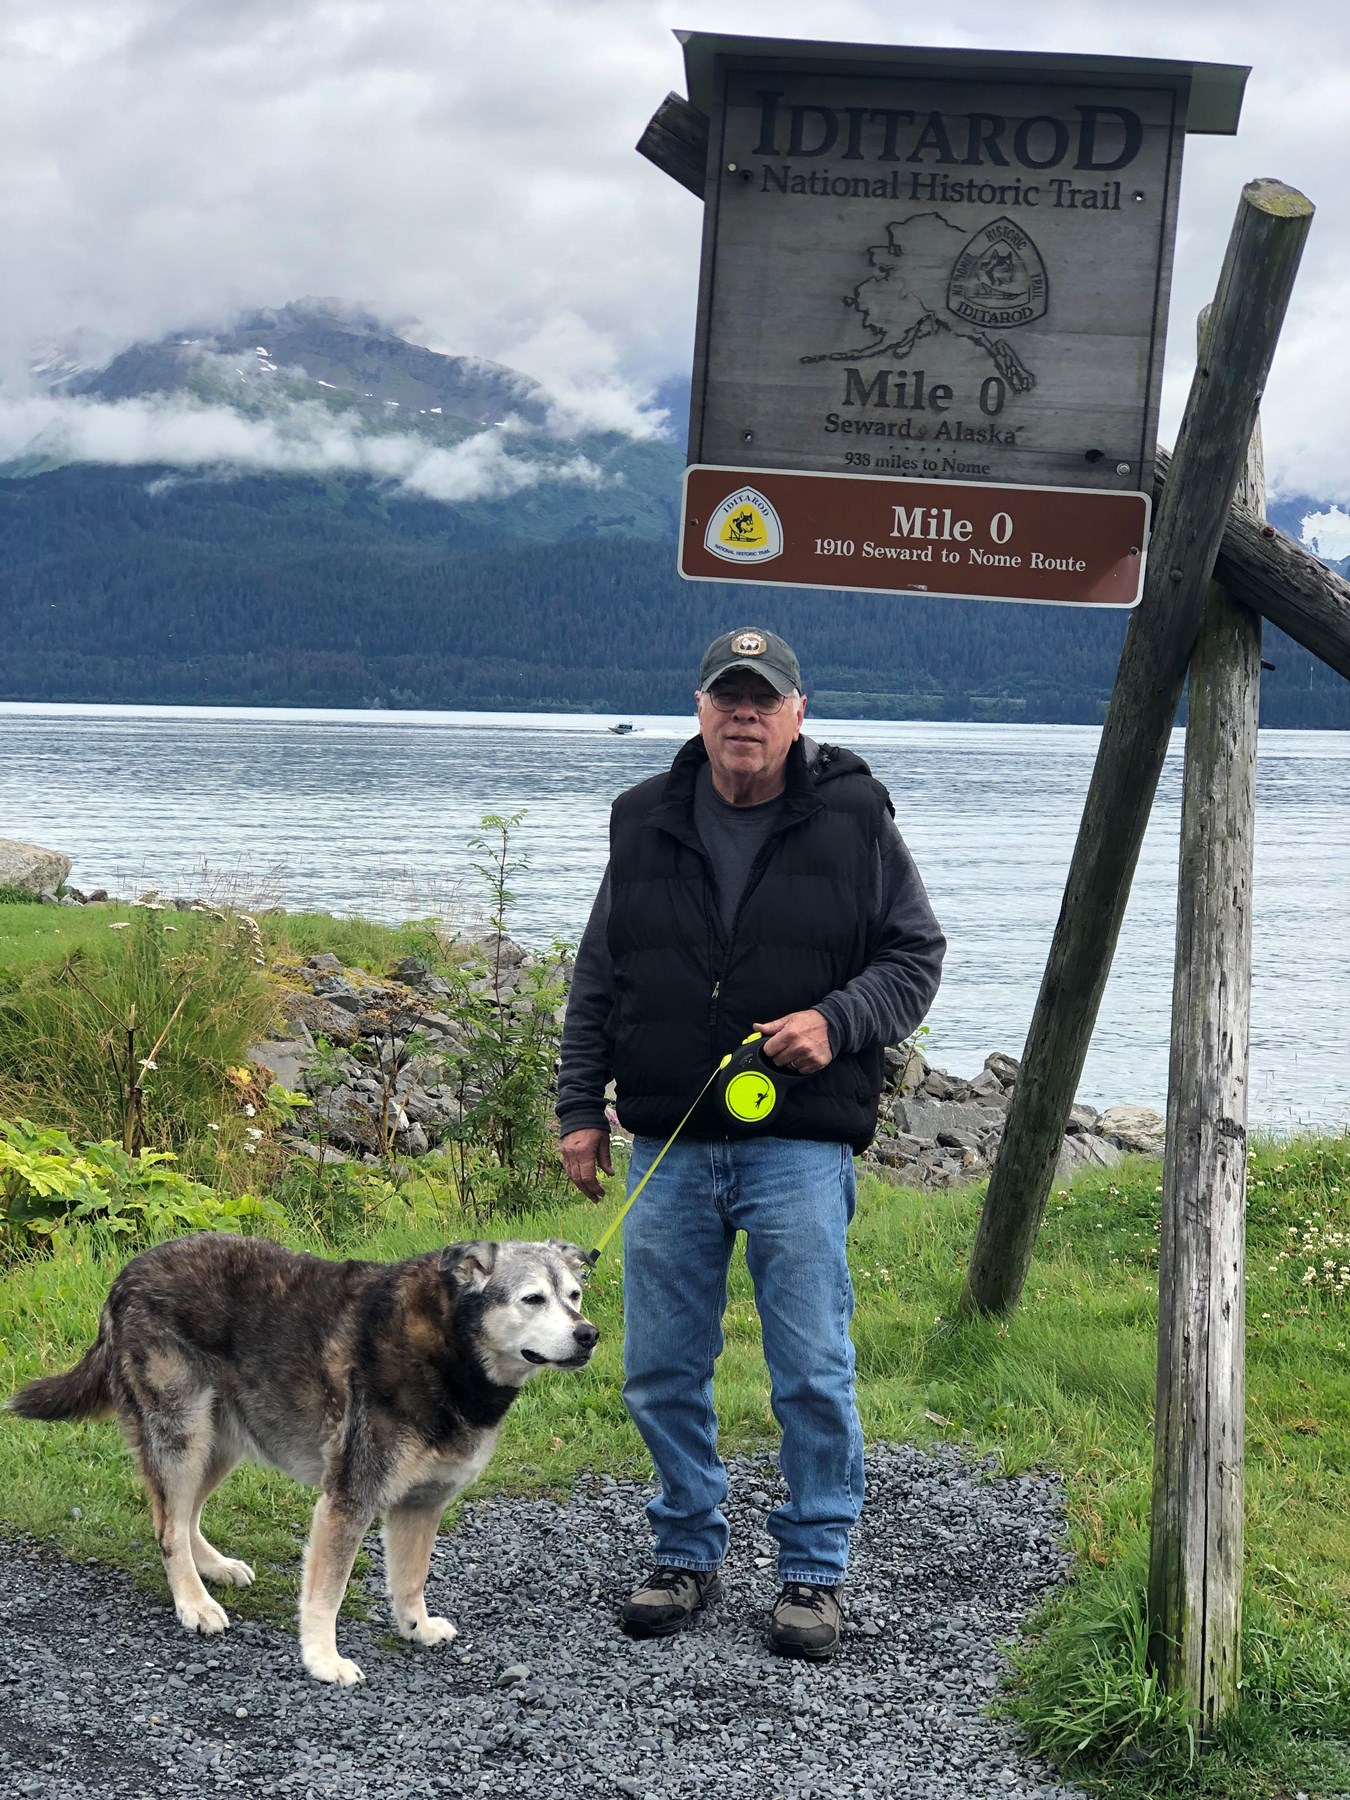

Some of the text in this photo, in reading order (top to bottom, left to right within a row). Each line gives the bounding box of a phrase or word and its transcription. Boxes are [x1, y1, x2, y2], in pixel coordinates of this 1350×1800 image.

[751, 90, 1144, 172] IDITAROD
[760, 163, 1121, 211] National Historic Trail
[984, 225, 1027, 251] HISTORIC
[1030, 272, 1044, 300] TRAIL
[956, 301, 1034, 324] IDITAROD
[841, 367, 1006, 416] Mile 0
[824, 412, 1018, 445] Seward Alaska
[844, 451, 991, 475] 938 miles to Nome
[723, 495, 769, 516] IDITAROD
[889, 505, 1014, 544] Mile 0
[813, 537, 1087, 572] 1910 Seward to Nome Route
